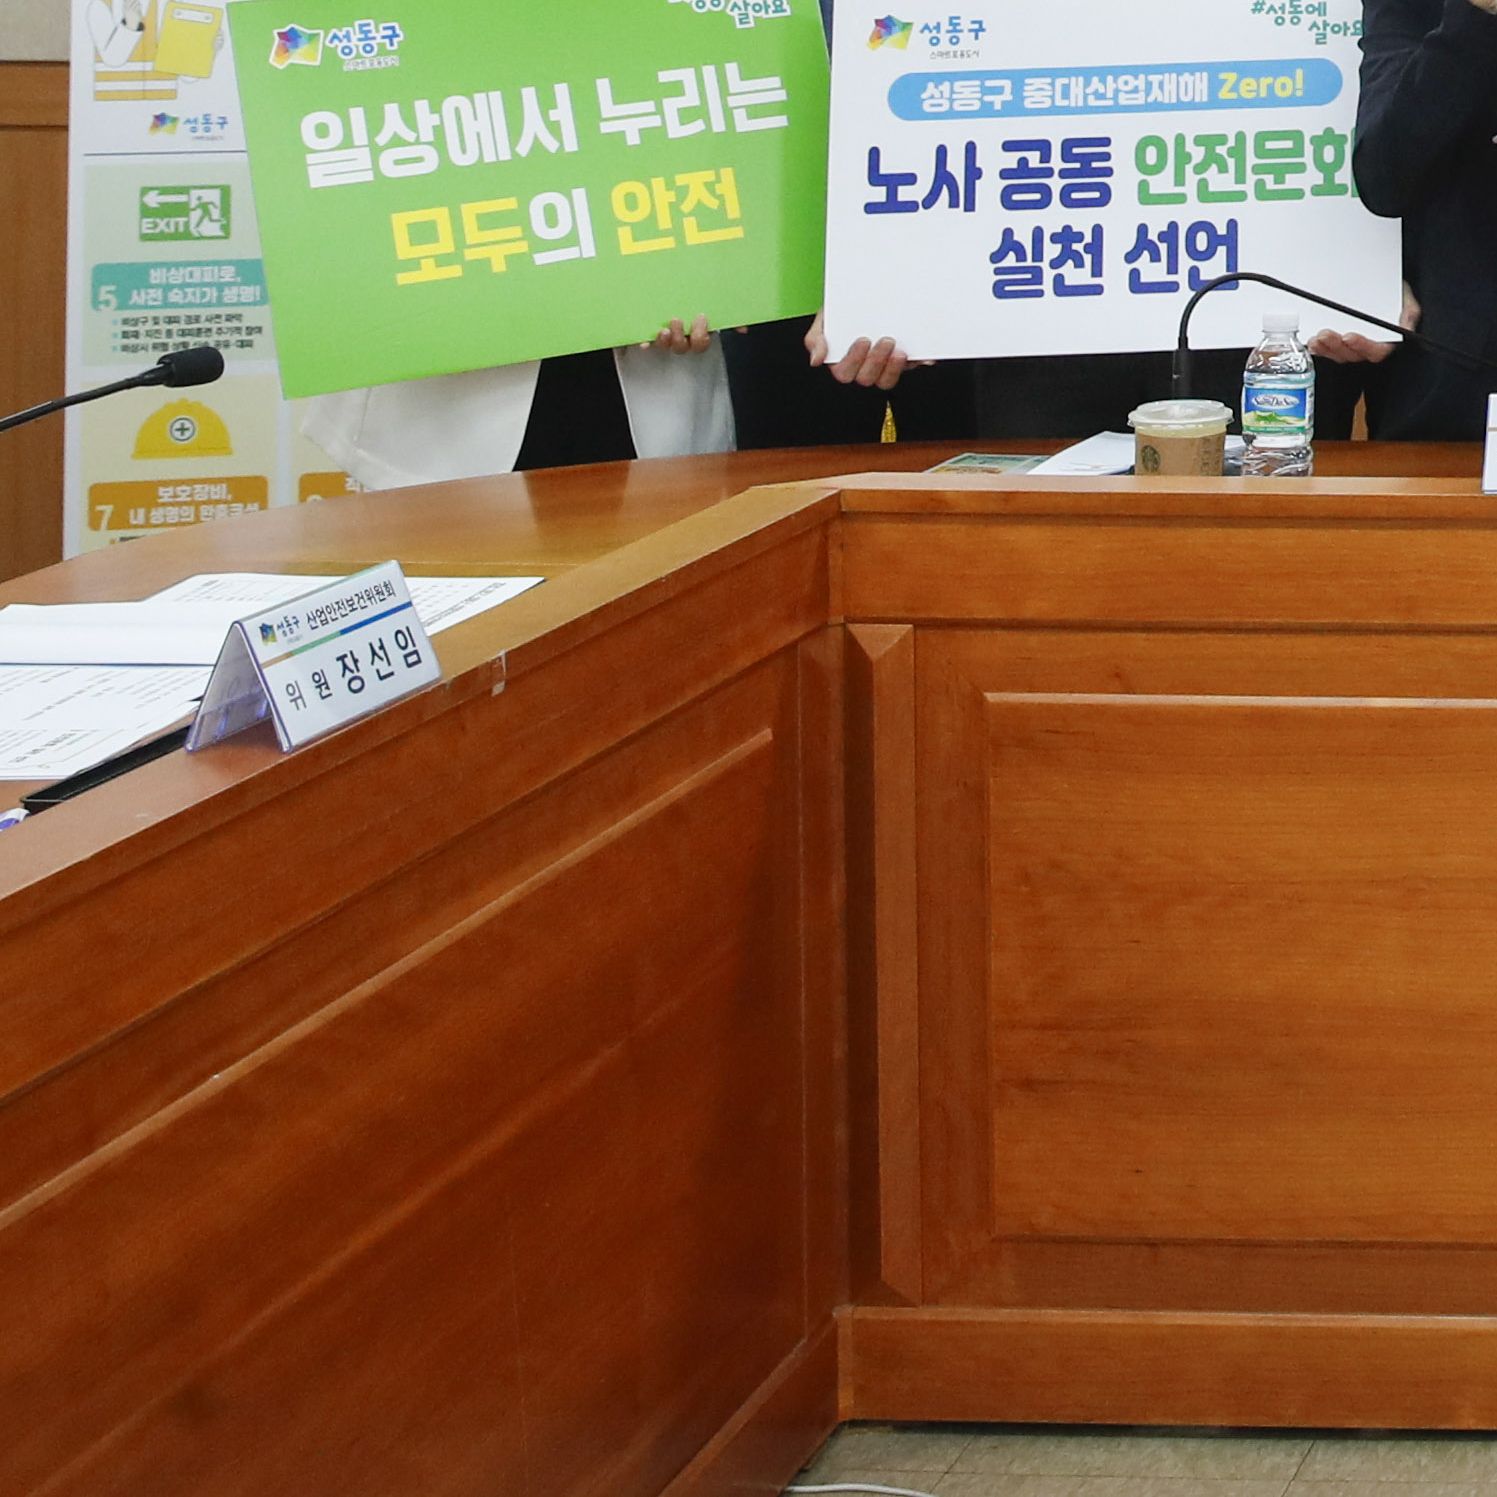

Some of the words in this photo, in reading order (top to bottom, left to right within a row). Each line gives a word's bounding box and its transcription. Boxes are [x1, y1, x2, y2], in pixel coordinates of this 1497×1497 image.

[327, 21, 401, 57] 성동구
[919, 15, 987, 47] 성동구
[1308, 19, 1363, 45] 살아요
[920, 78, 1014, 114] 성동구
[1022, 70, 1209, 111] 중대산업재해
[1217, 68, 1304, 101] Zero!
[183, 113, 229, 134] 성동구
[300, 82, 581, 189] 일상에서
[595, 61, 790, 147] 누리는
[863, 139, 983, 216] 노사
[998, 136, 1115, 211] 공동
[1134, 126, 1360, 206] 안전문화
[141, 217, 189, 234] EXIT
[390, 187, 596, 286] 모두의
[610, 167, 745, 256] 안전
[989, 222, 1105, 300] 실천
[1123, 218, 1241, 296] 선언
[149, 265, 242, 285] 비상대피로,
[98, 285, 118, 311] 5
[128, 288, 163, 305] 사전
[167, 286, 217, 304] 숙지가
[222, 285, 261, 303] 생명!
[157, 483, 233, 503] 보호장비,
[95, 505, 114, 530] 7
[129, 508, 145, 525] 내
[276, 615, 300, 637] 성동구
[306, 579, 396, 630] 산업안전보건위원회
[285, 668, 333, 711] 위원
